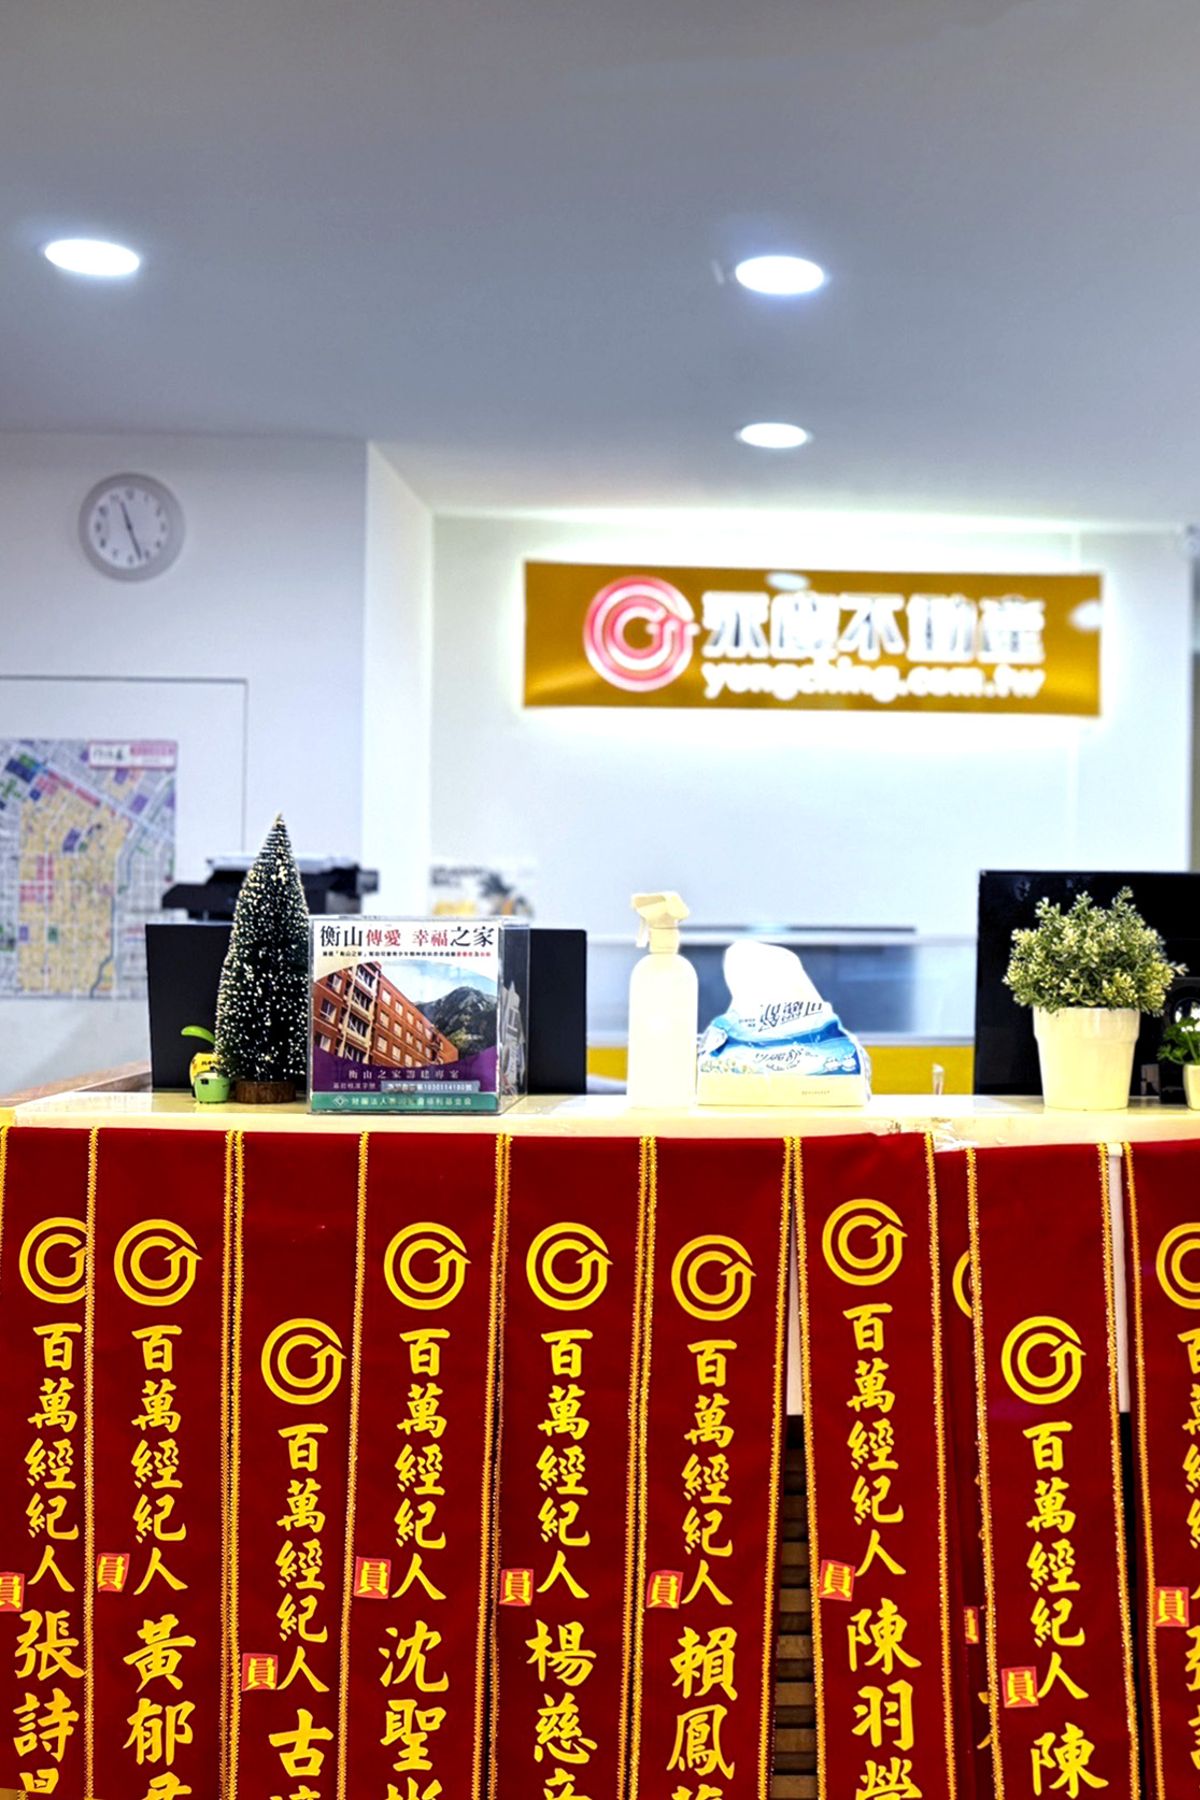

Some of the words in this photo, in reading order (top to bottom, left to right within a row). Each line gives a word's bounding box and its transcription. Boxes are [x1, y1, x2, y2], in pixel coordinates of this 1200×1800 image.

[320, 925, 401, 948] 衡山傳愛
[412, 925, 495, 948] 幸福之家
[25, 1323, 82, 1592] 百萬經紀人
[131, 1325, 187, 1595] 百萬經紀人
[392, 1329, 450, 1600] 百萬經紀人
[536, 1329, 592, 1599] 百萬經紀人
[682, 1340, 736, 1606] 百萬經紀人
[843, 1303, 906, 1577] 百萬經紀人
[97, 1556, 124, 1591] 員
[277, 1424, 329, 1692] 百萬經紀人
[356, 1561, 388, 1596] 員
[501, 1570, 531, 1605] 員
[647, 1575, 678, 1609] 員
[821, 1563, 853, 1599] 員
[1022, 1421, 1088, 1700] 百萬經紀人
[1156, 1589, 1186, 1625] 員
[244, 1658, 276, 1690] 員
[667, 1627, 738, 1800] 賴鳳
[1006, 1671, 1037, 1707] 員
[269, 1709, 334, 1800] 古
[1031, 1723, 1109, 1799] 陳
